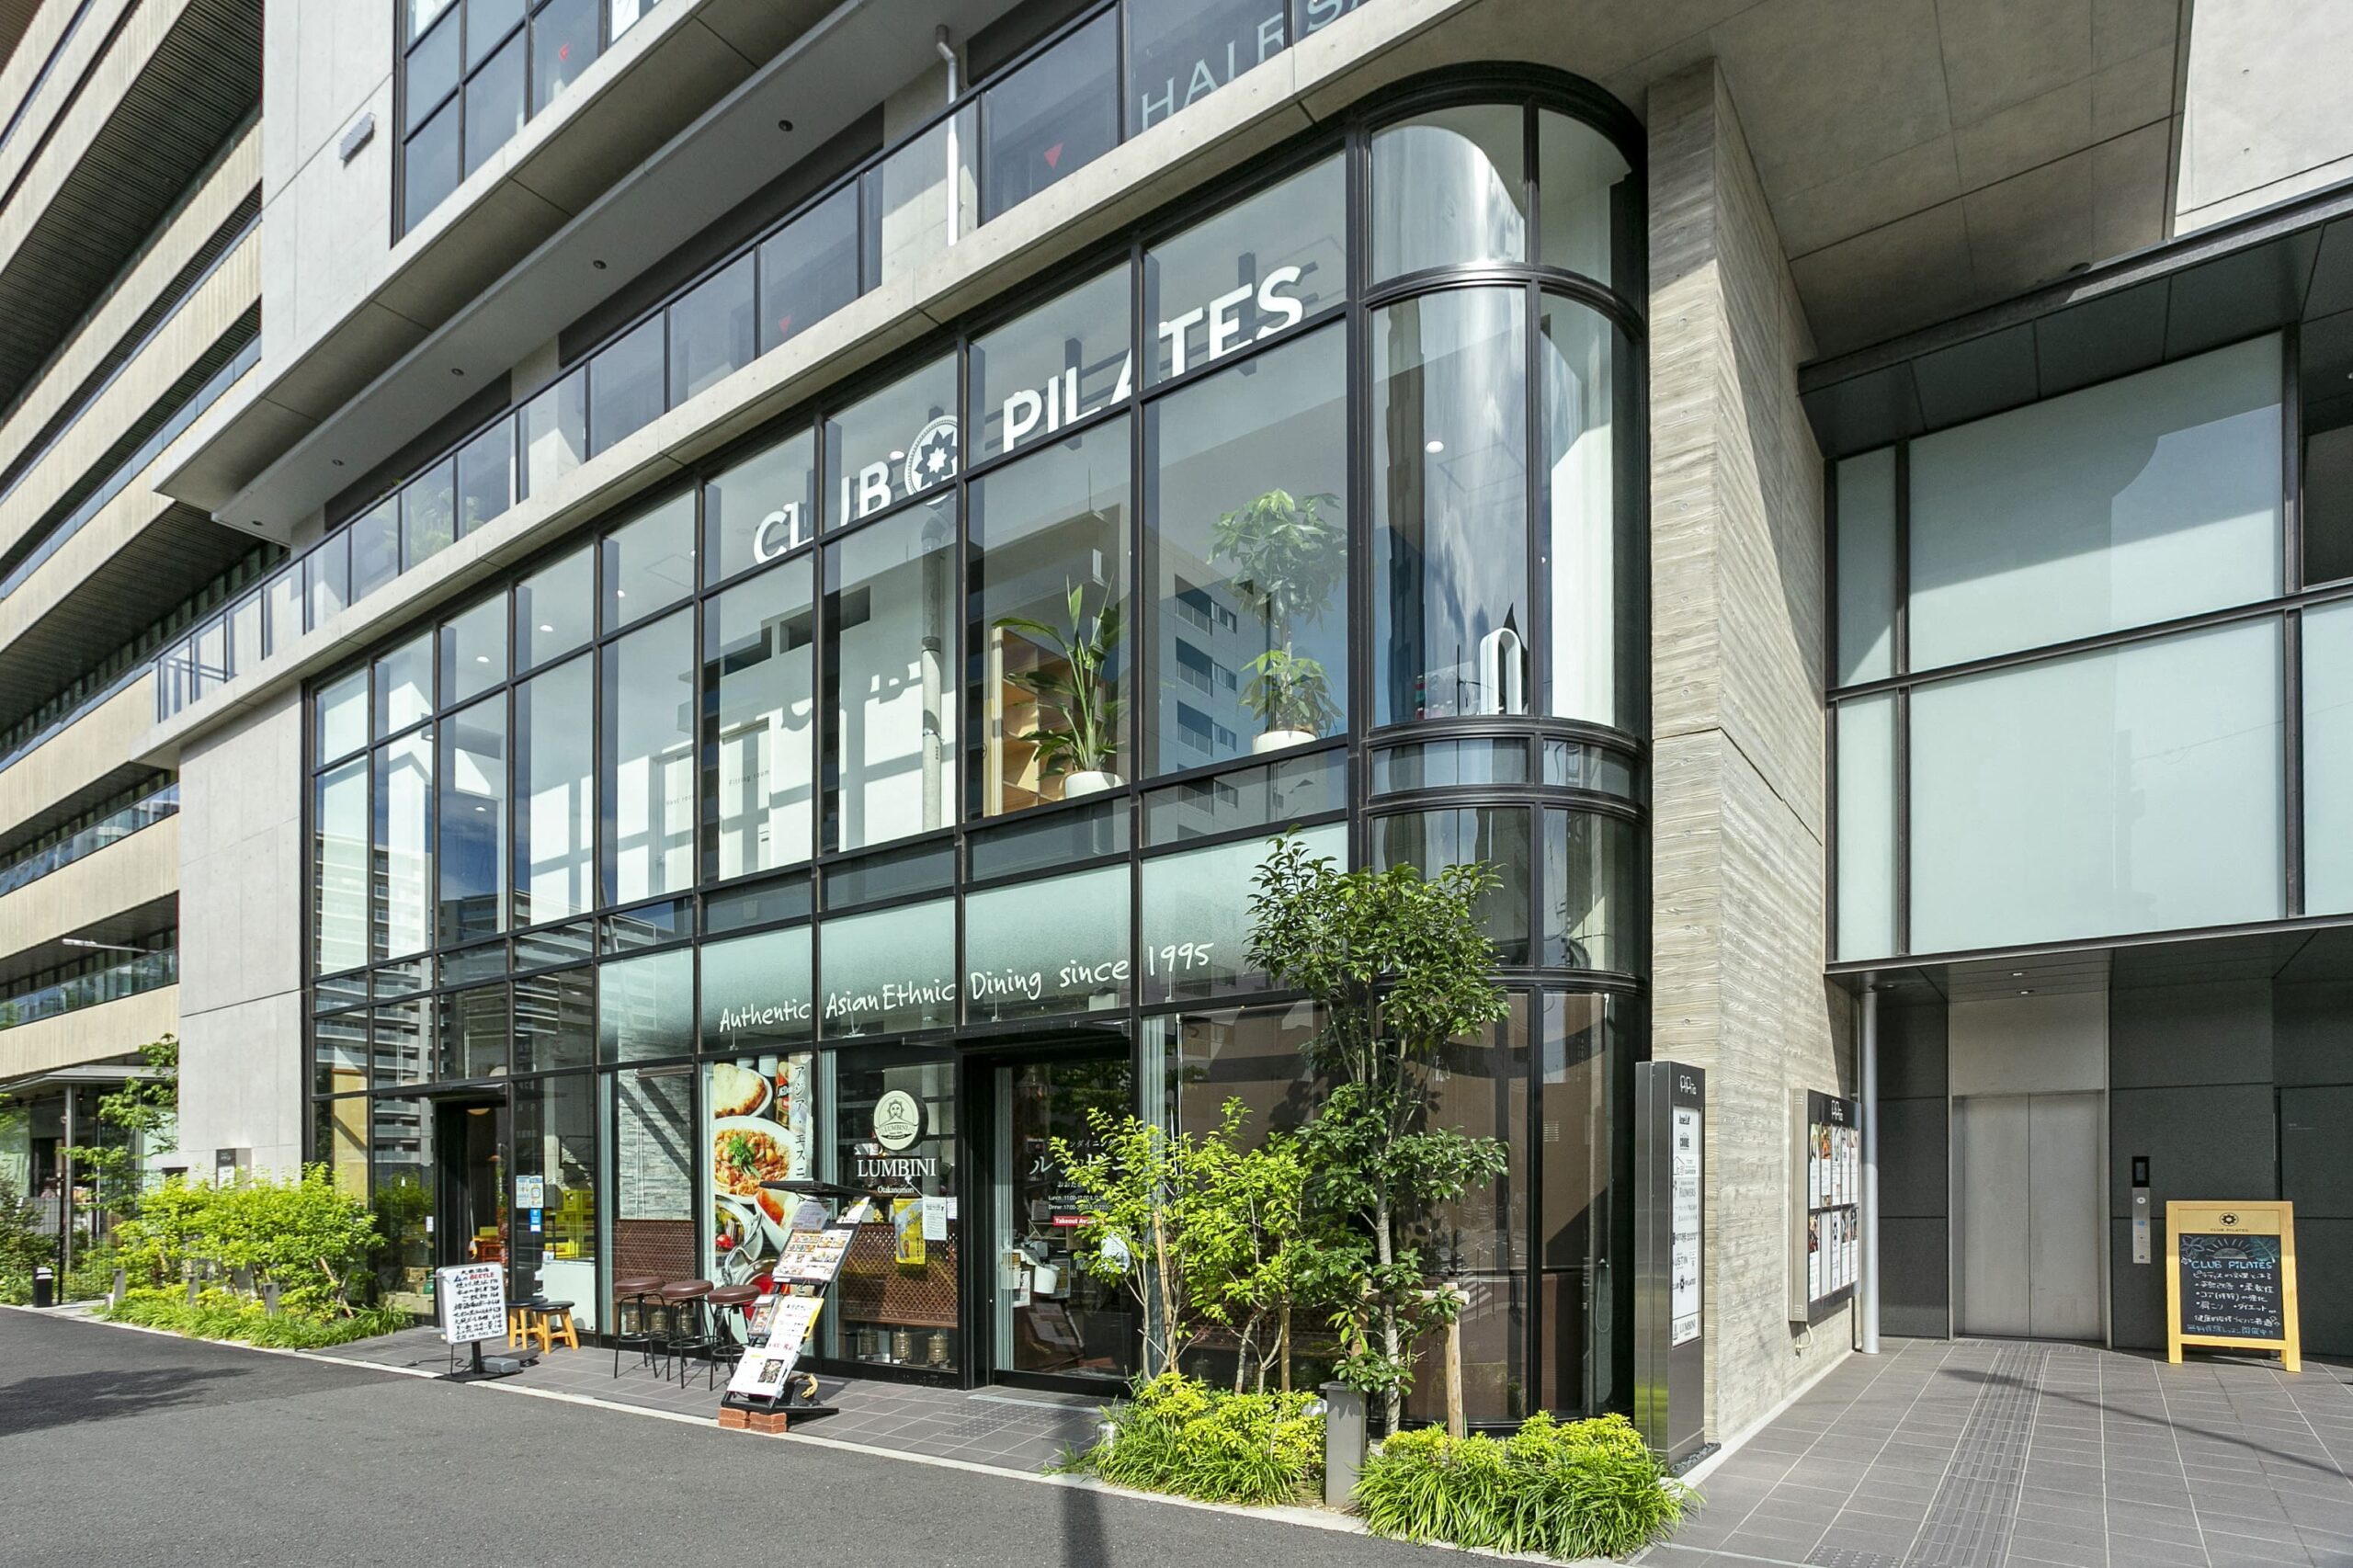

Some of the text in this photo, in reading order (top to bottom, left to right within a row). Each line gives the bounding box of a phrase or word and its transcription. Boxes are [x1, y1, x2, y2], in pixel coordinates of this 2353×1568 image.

[1142, 12, 1284, 131] HAIR
[718, 941, 1216, 1033] Authentic Asian Ethnic Dining since 1995
[857, 1158, 937, 1177] LUMBINI
[1673, 1256, 1688, 1267] USTIN
[2190, 1260, 2222, 1269] CLUB
[470, 1271, 495, 1280] BEETLE
